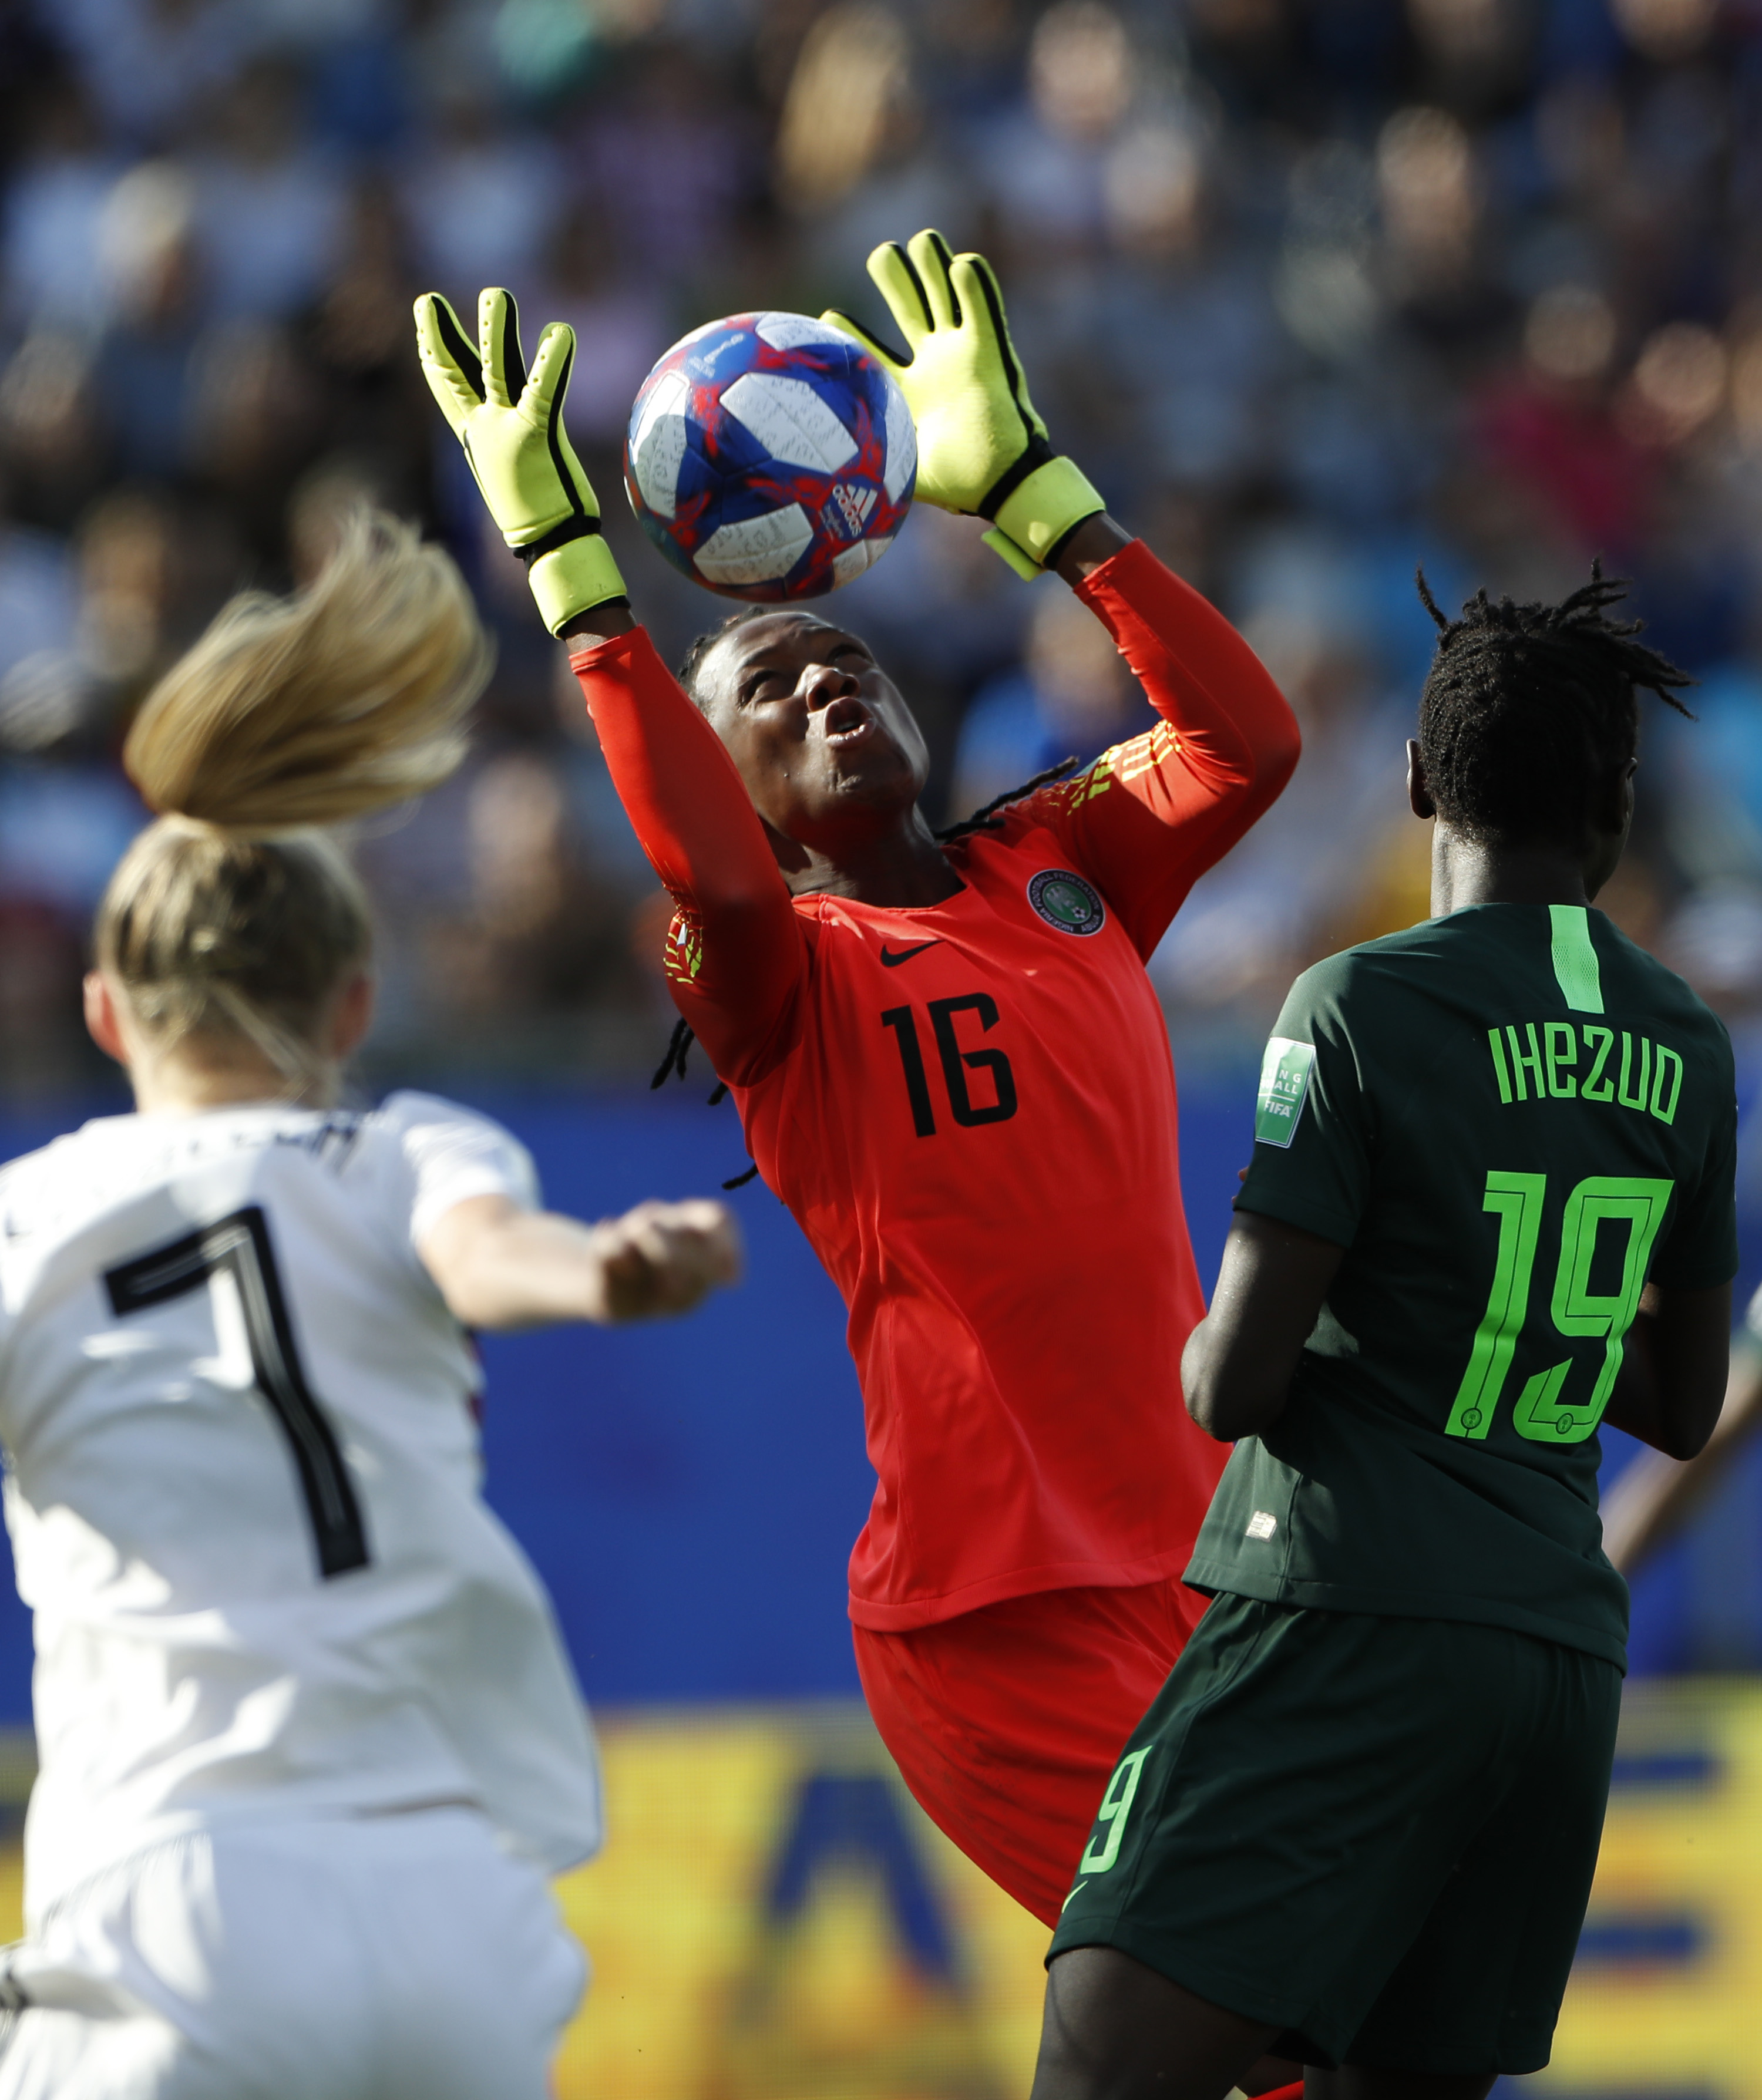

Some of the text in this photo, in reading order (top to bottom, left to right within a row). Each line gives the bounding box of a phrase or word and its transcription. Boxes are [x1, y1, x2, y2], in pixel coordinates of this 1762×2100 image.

[832, 483, 862, 538] adidas
[881, 992, 1017, 1138] 16
[1263, 1100, 1291, 1118] FIFA
[1444, 1170, 1675, 1443] 19
[104, 1204, 371, 1579] 7
[1080, 1745, 1153, 1875] 9
